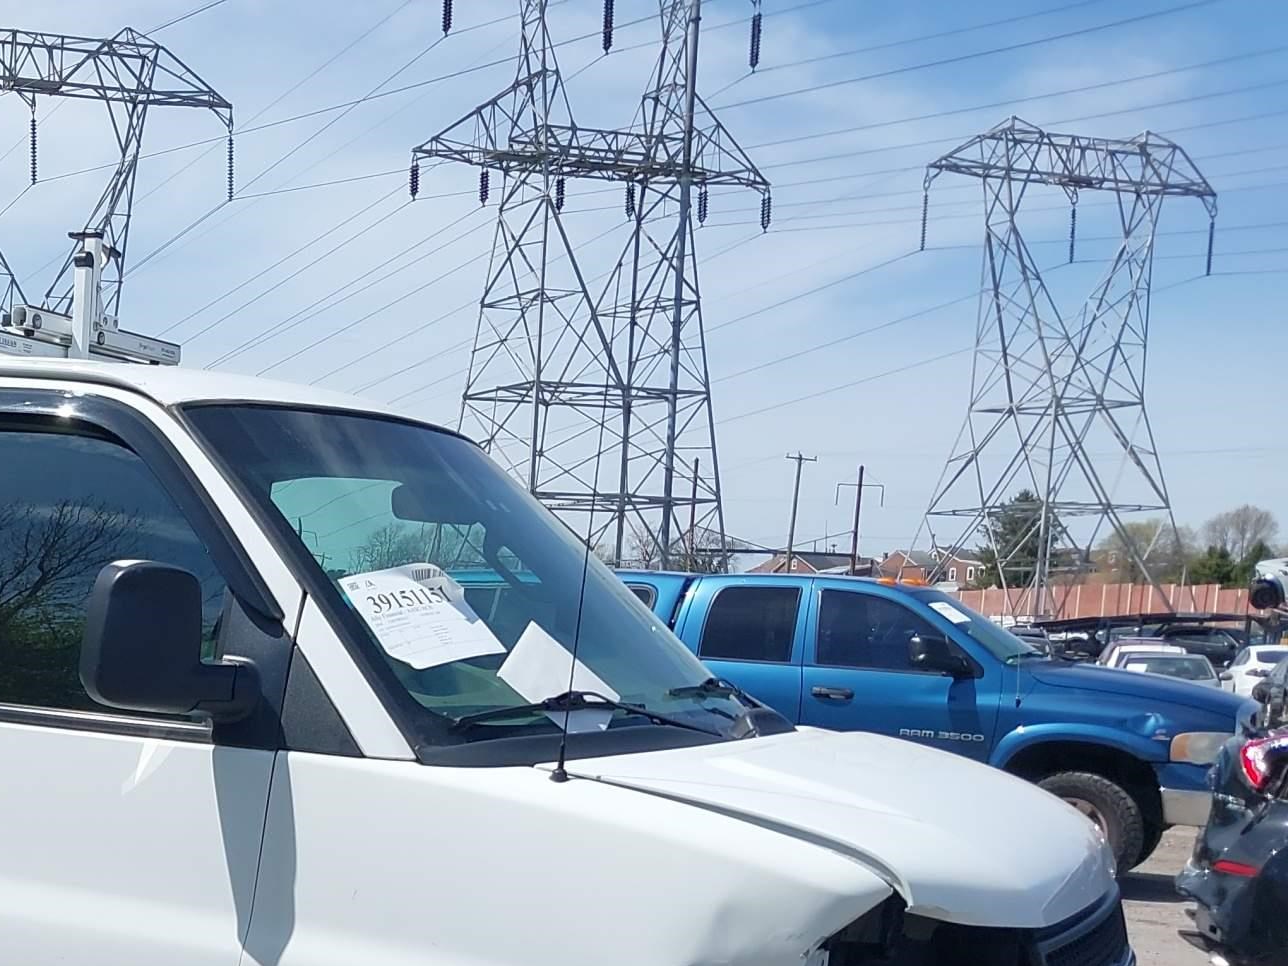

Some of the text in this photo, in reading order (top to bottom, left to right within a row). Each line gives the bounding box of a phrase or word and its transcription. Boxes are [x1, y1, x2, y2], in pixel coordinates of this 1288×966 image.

[366, 586, 452, 614] 39151151
[899, 728, 985, 742] RAM 3500
